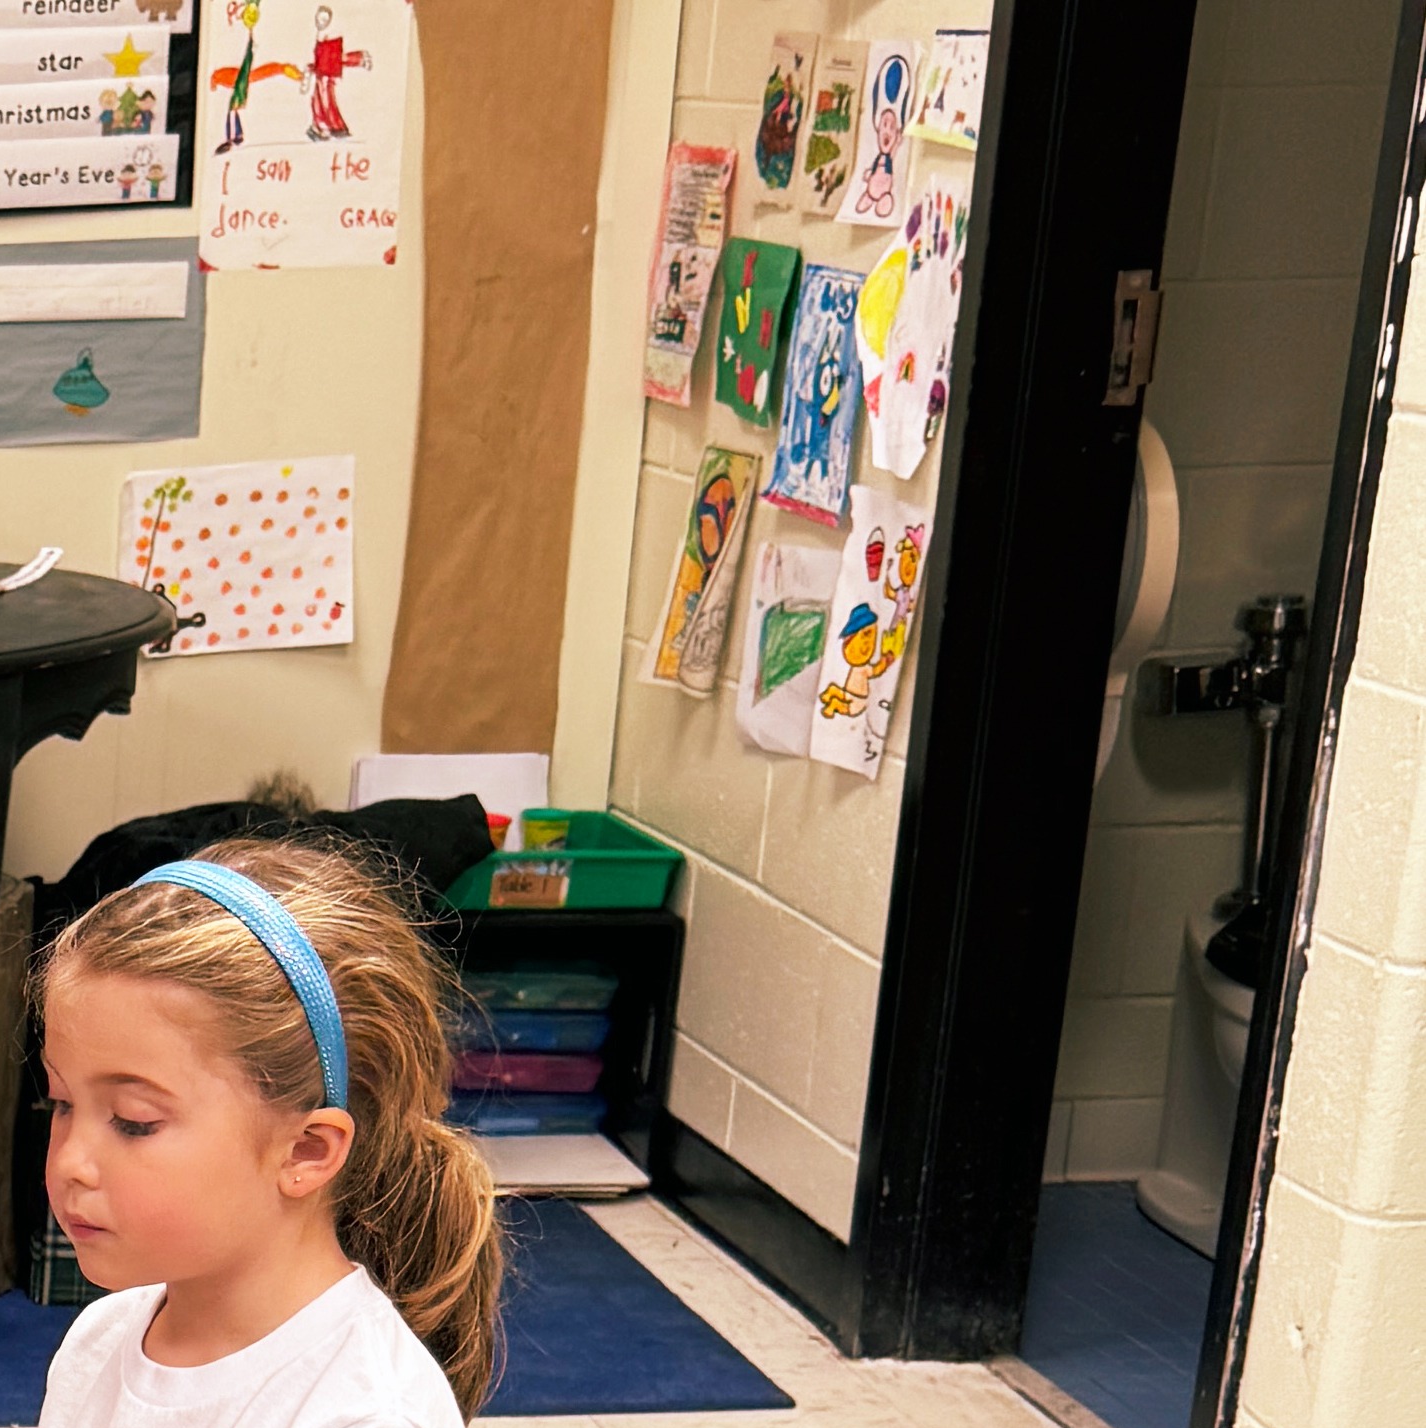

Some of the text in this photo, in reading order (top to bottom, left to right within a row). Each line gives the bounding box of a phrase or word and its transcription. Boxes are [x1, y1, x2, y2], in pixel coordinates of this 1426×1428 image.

[37, 53, 83, 72] star
[4, 167, 70, 187] Year's
[78, 166, 115, 184] Eve
[222, 161, 230, 195] I
[330, 151, 370, 183] the
